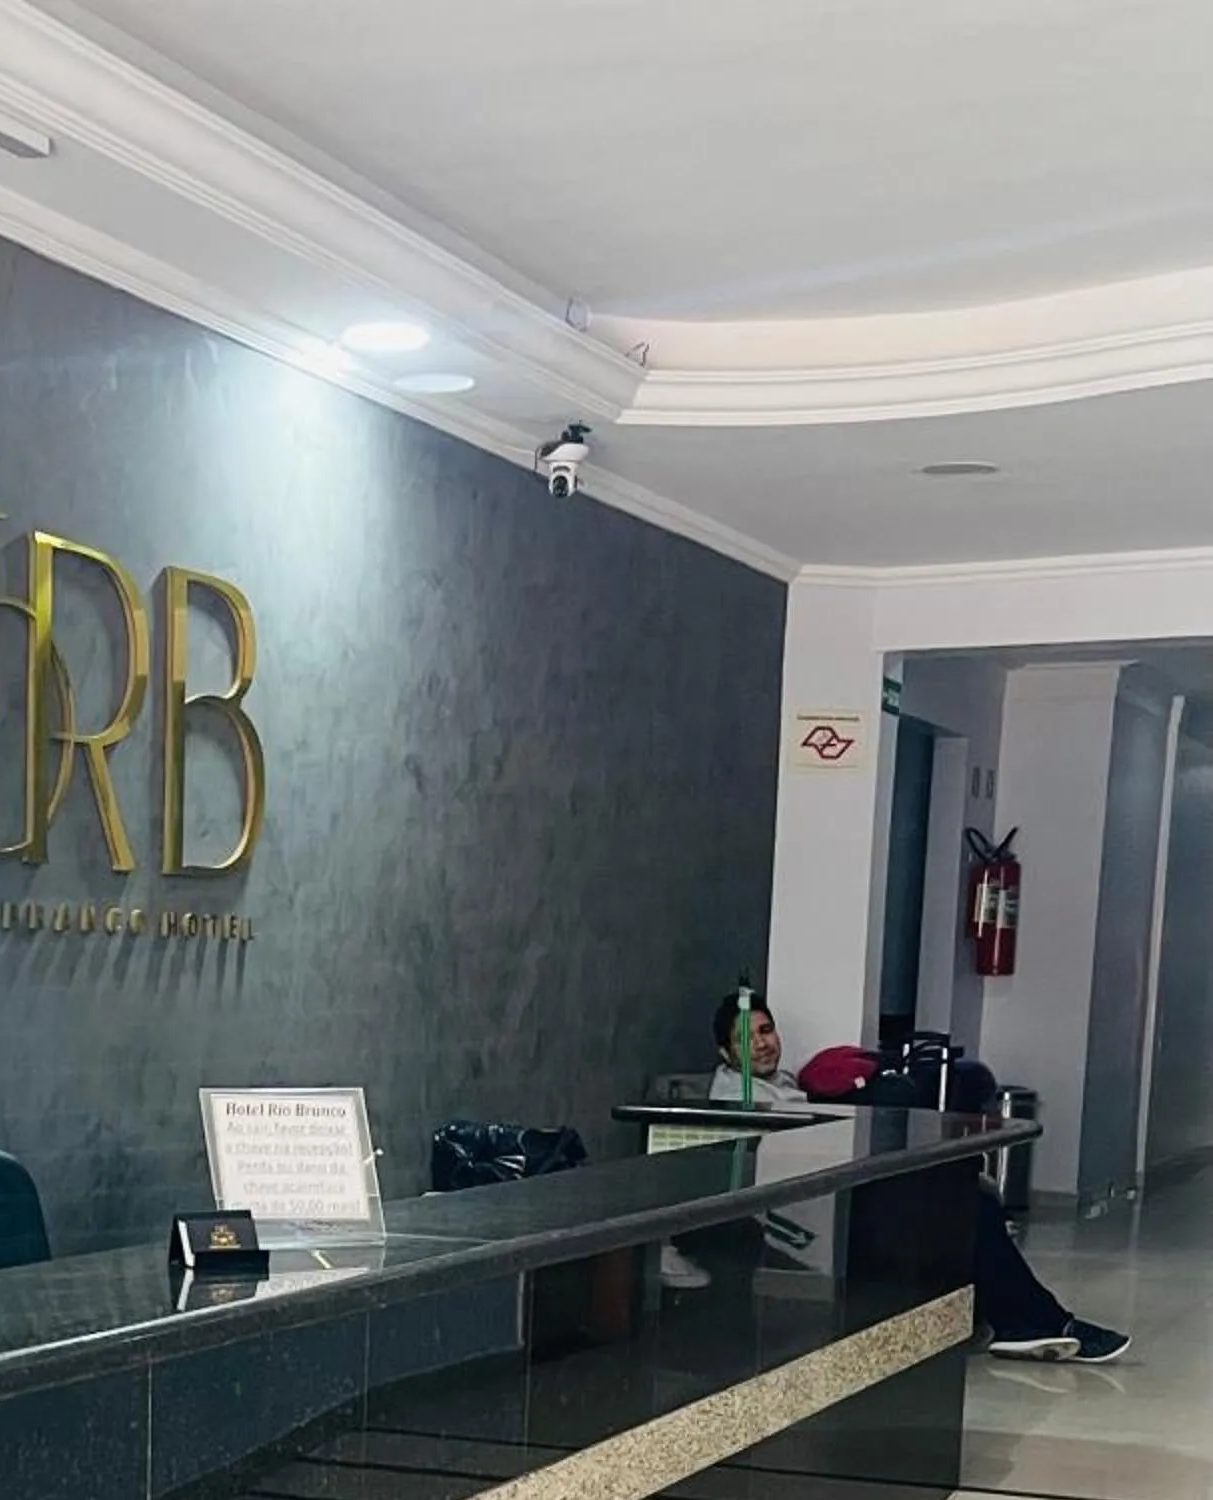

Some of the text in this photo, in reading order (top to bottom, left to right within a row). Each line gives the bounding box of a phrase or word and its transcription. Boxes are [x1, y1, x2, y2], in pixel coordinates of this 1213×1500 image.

[160, 911, 255, 941] HOTEL
[226, 1102, 265, 1117] Hotel
[268, 1103, 292, 1117] Rio
